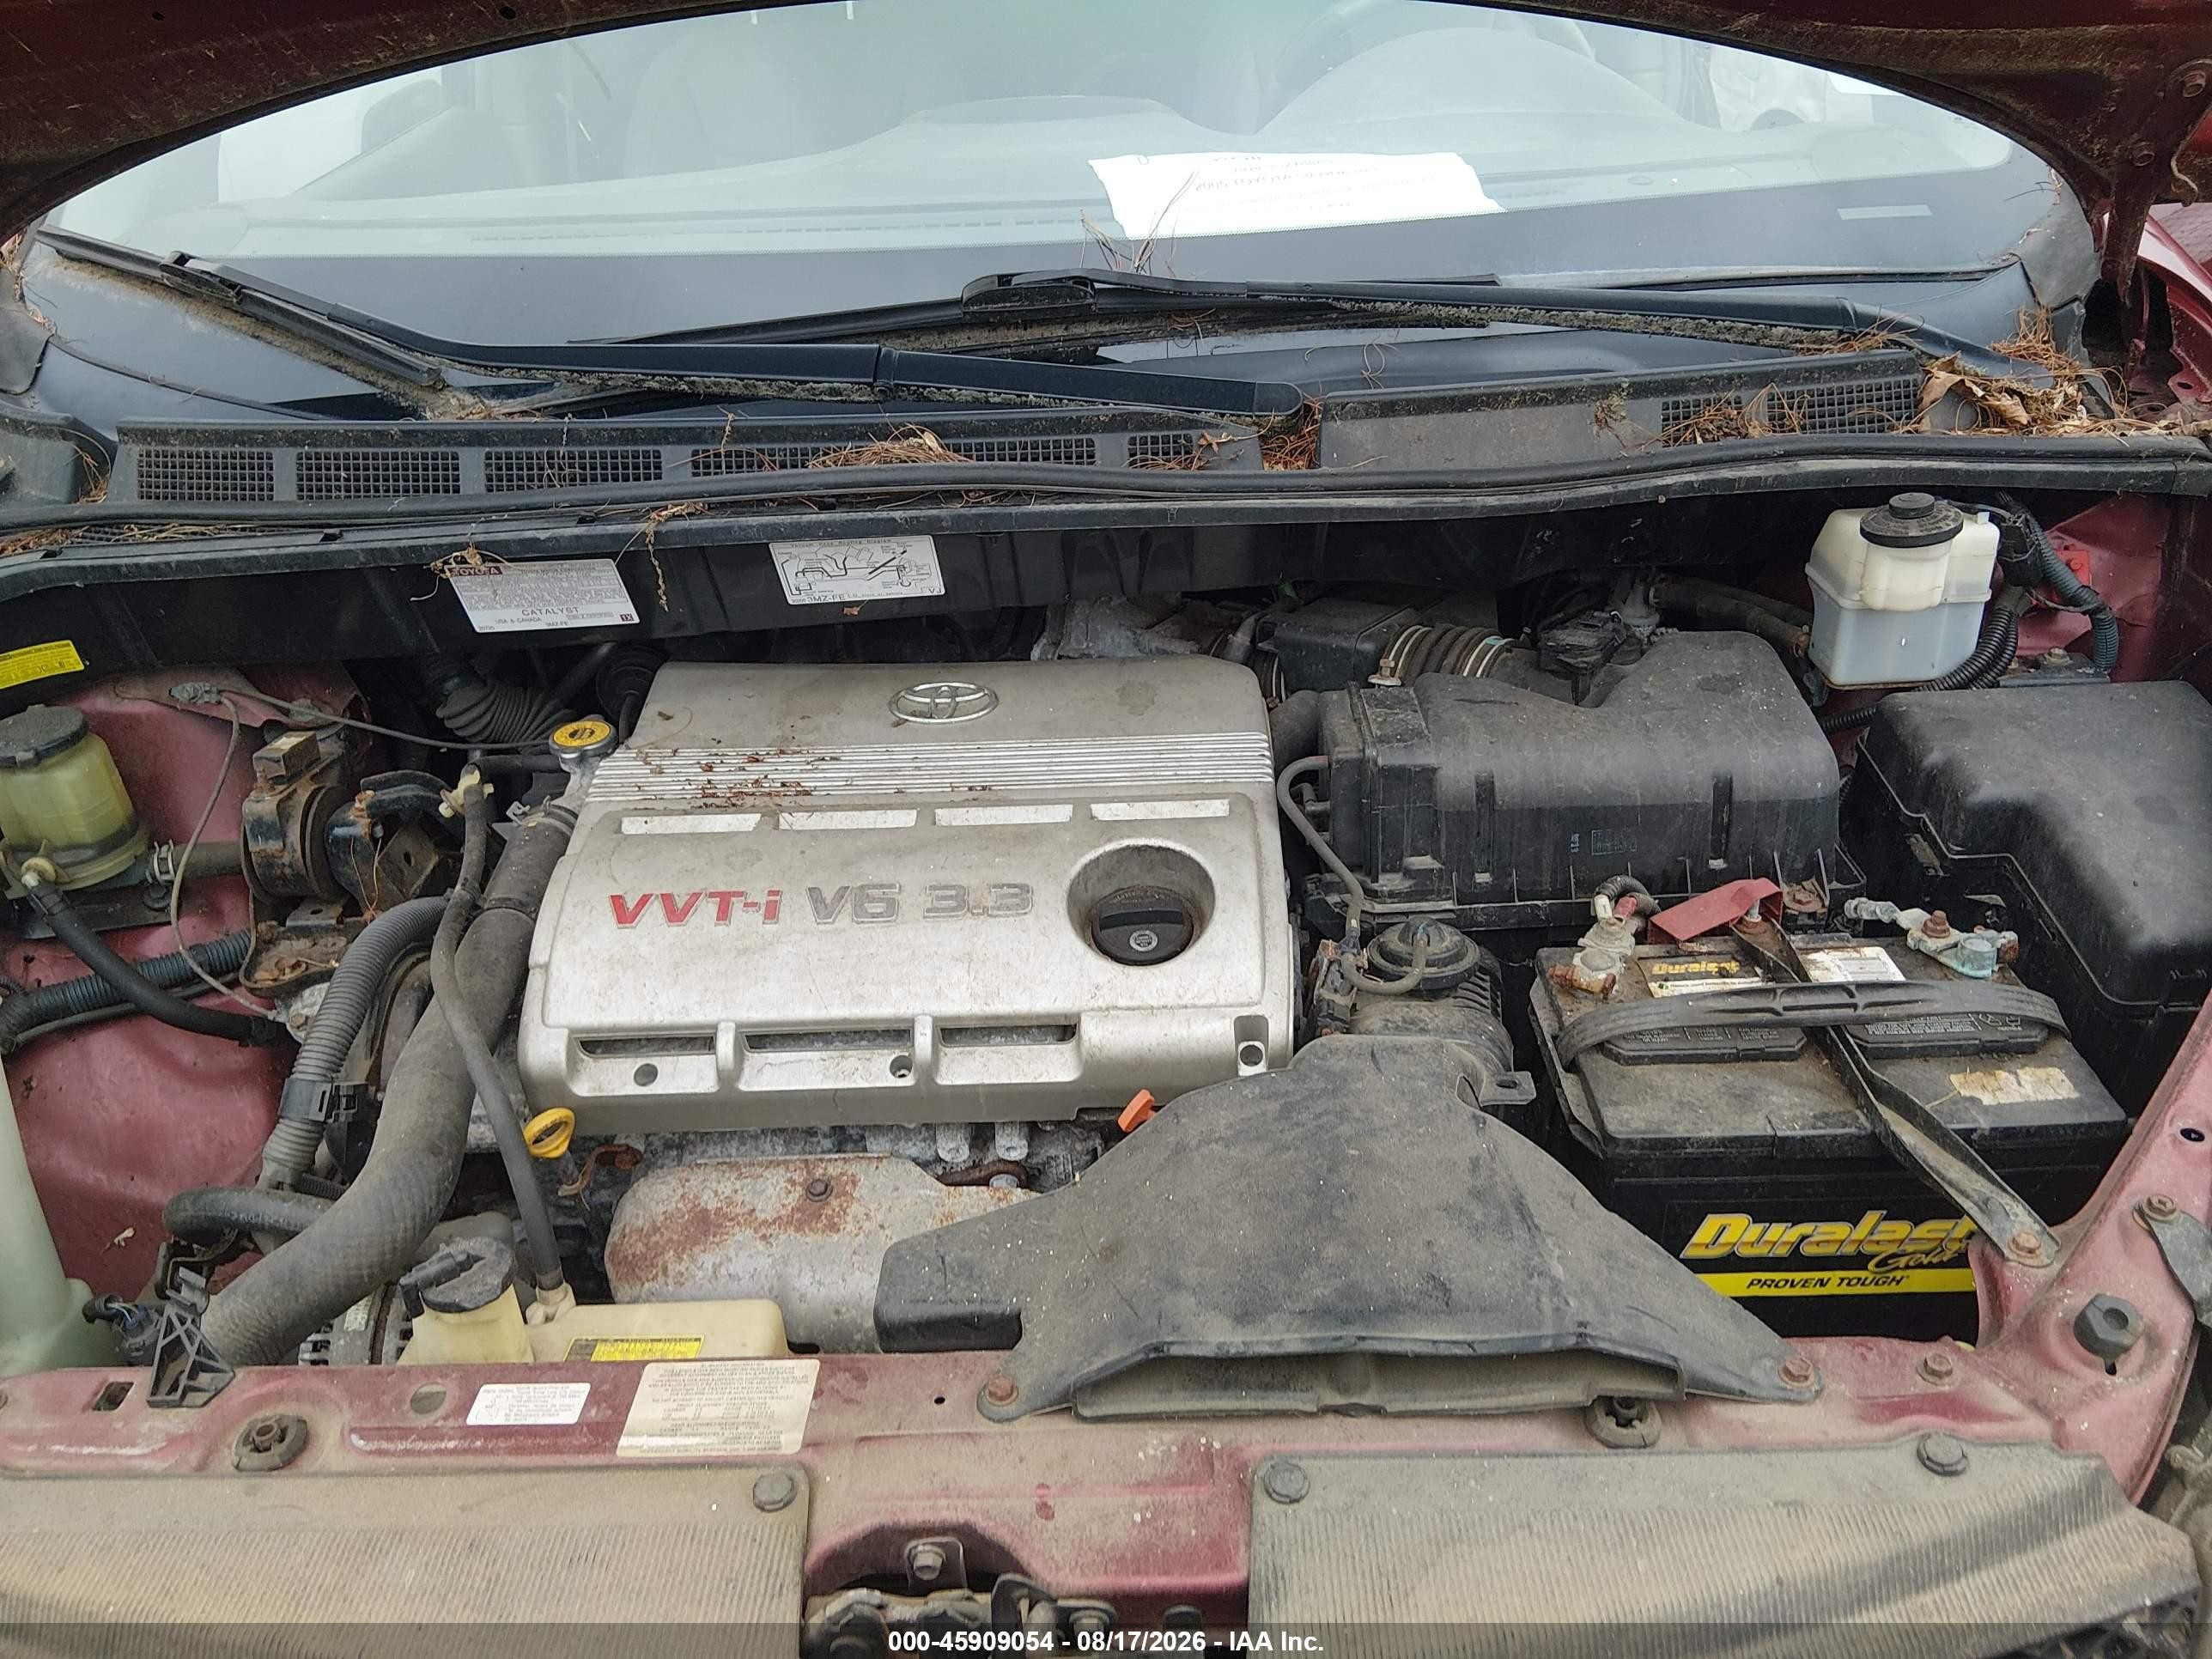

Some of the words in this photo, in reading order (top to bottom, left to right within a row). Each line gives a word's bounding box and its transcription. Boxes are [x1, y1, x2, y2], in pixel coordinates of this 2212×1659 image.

[520, 606, 580, 617] CATALYST
[609, 890, 783, 929] VVT-i
[805, 883, 902, 926] V6
[922, 883, 1034, 919] 3.3
[1679, 1209, 1978, 1260] Duralast
[1867, 1245, 1963, 1274] Gold
[1746, 1276, 1831, 1290] PROVEN
